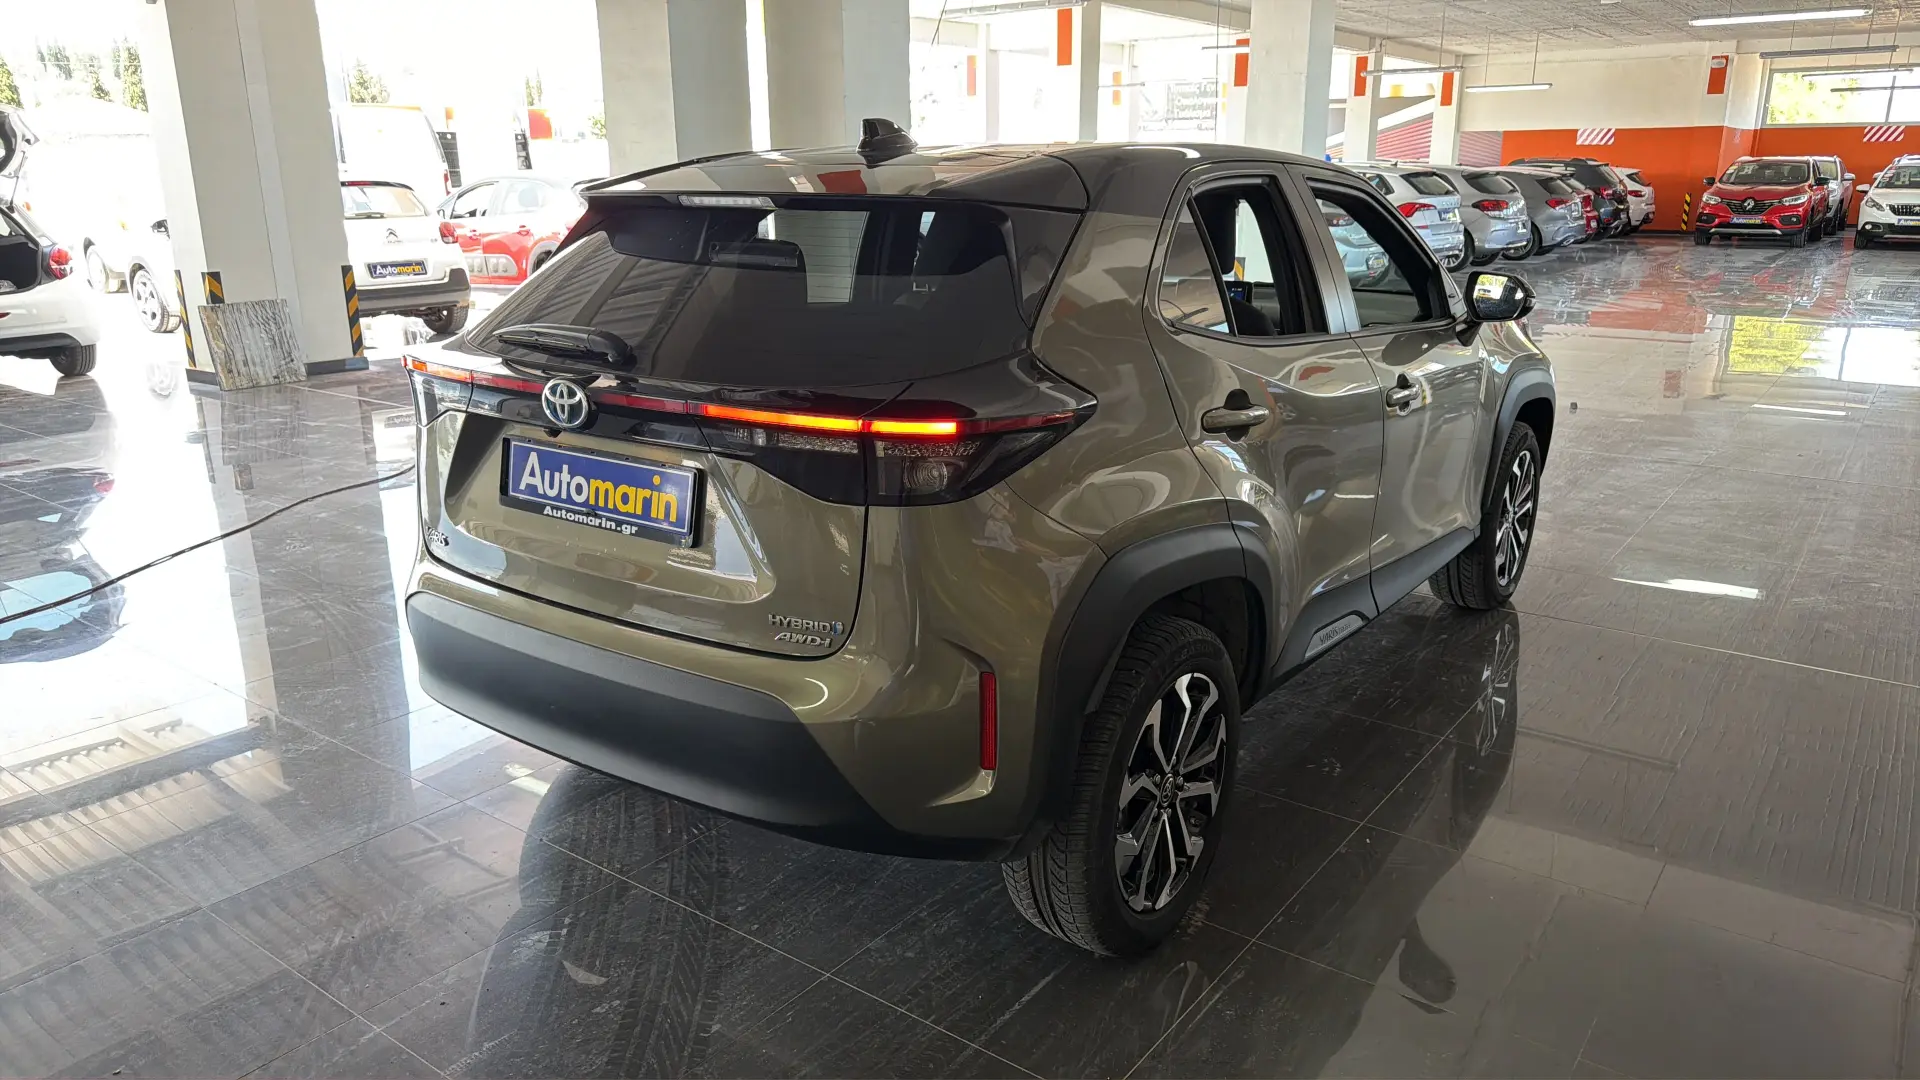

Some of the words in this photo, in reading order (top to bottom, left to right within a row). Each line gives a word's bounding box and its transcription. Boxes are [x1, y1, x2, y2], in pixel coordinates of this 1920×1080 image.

[376, 262, 422, 275] Automarin
[518, 451, 678, 523] Automarin
[543, 505, 639, 535] Automarin.gr
[768, 613, 833, 634] HYBRID
